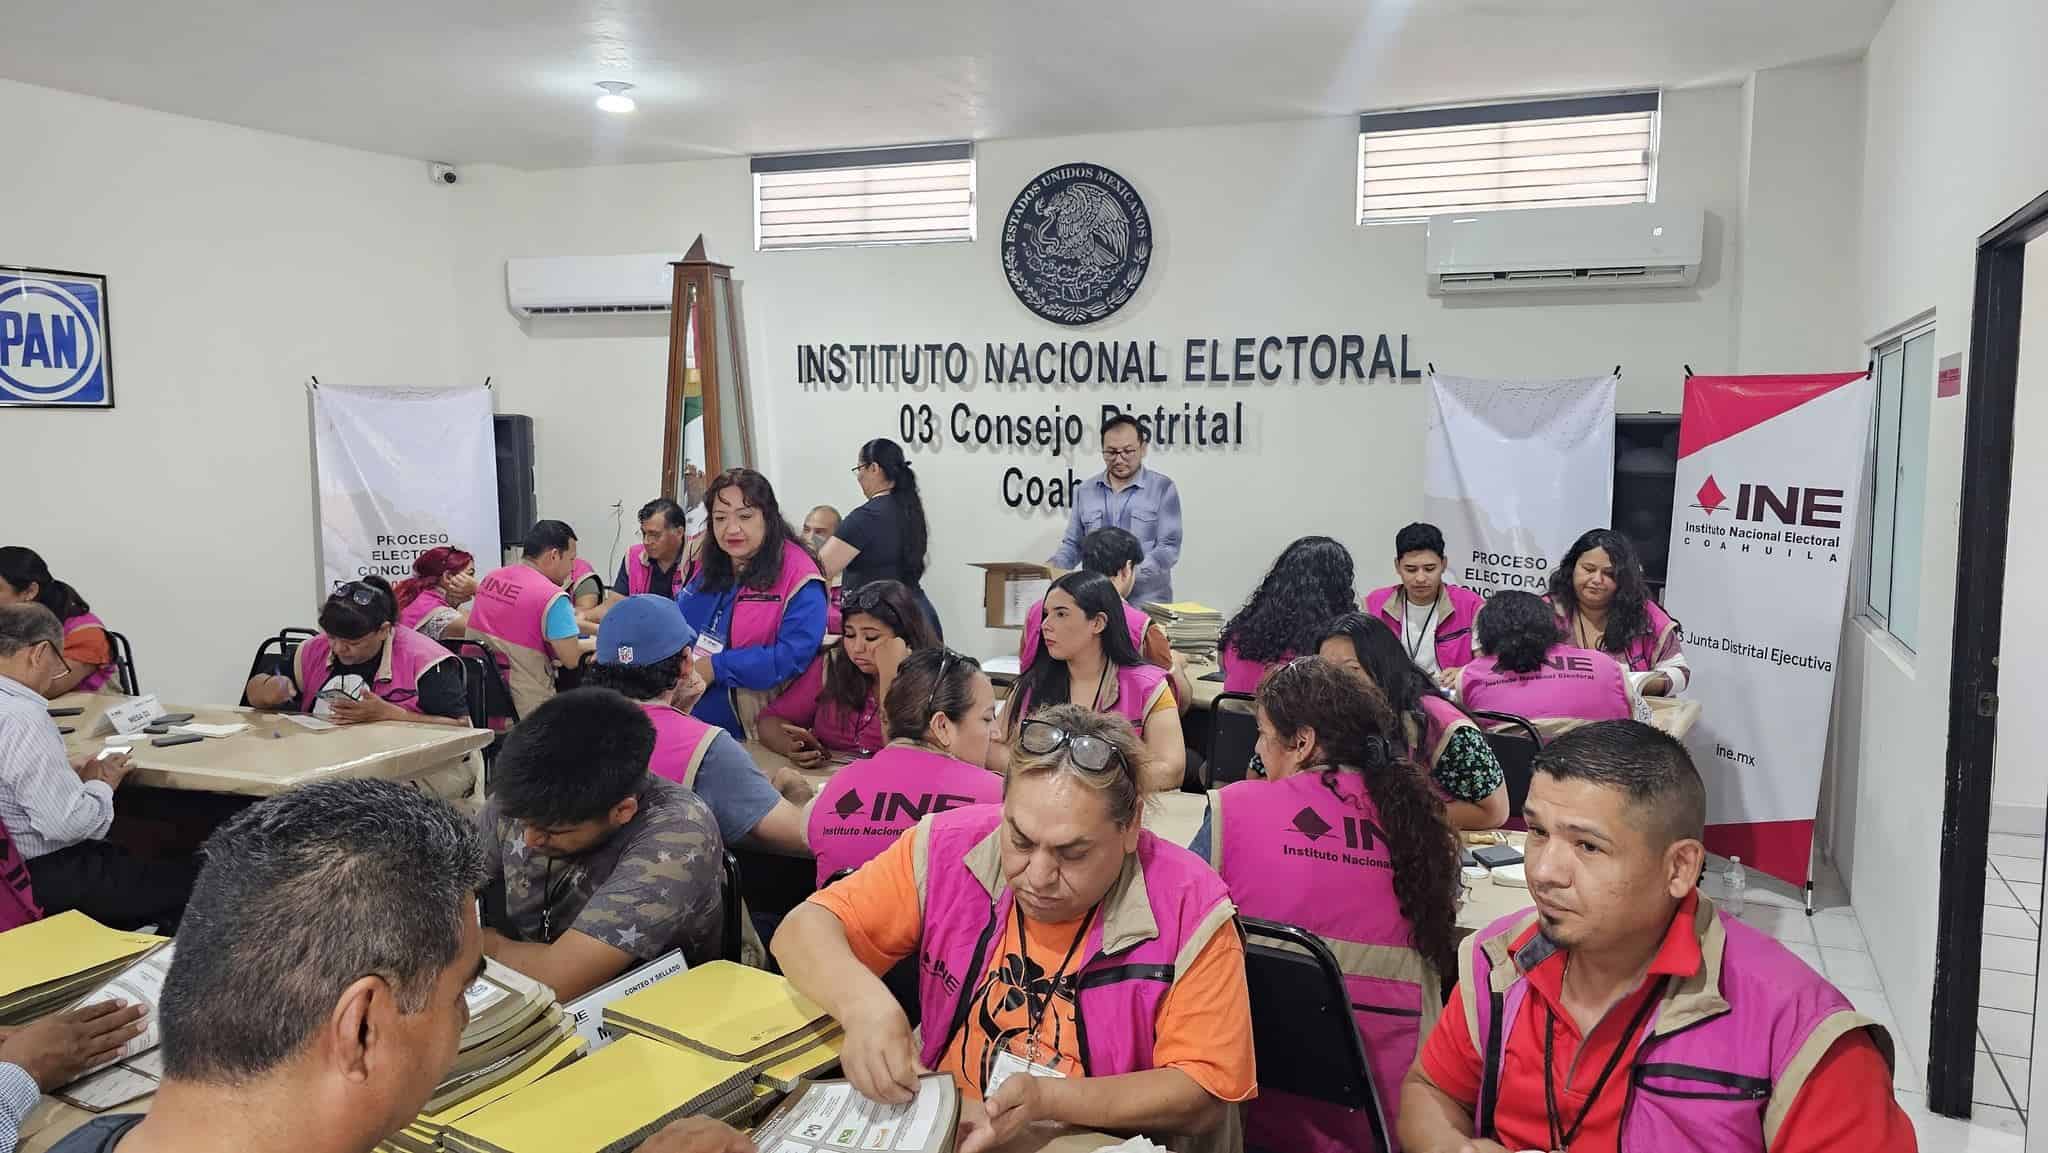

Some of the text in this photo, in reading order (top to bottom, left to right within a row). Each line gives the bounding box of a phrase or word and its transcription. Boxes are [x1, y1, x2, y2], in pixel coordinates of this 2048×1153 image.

[1006, 167, 1148, 242] ESTADOS UNIDOS MEXICANOS
[0, 310, 77, 369] PAN
[797, 334, 1422, 384] INSTITUTO NACIONAL ELECTORAL
[900, 401, 1243, 456] 03 Consejo strital
[1003, 467, 1083, 508] Coah
[1735, 483, 1844, 529] INE
[376, 533, 449, 546] PROCESO
[1685, 521, 1840, 548] Instituto Nacional Electoral
[1472, 550, 1547, 570] PROCESO
[1684, 537, 1838, 563] COAHUILA
[358, 565, 410, 577] CONCU
[1465, 567, 1548, 589] ELECTORA
[485, 577, 523, 601] INE
[1542, 656, 1593, 672] NE
[1687, 631, 1719, 650] Junta
[1722, 638, 1768, 660] Distrital
[1771, 648, 1832, 672] Ejecutiva
[1716, 743, 1755, 767] ine.mx
[823, 826, 904, 837] Instituto Naciona
[1343, 816, 1392, 851] IN
[1283, 844, 1338, 862] Instituto
[624, 979, 650, 996] CONTEO
[655, 963, 681, 980] SELLADO
[933, 959, 961, 997] INE
